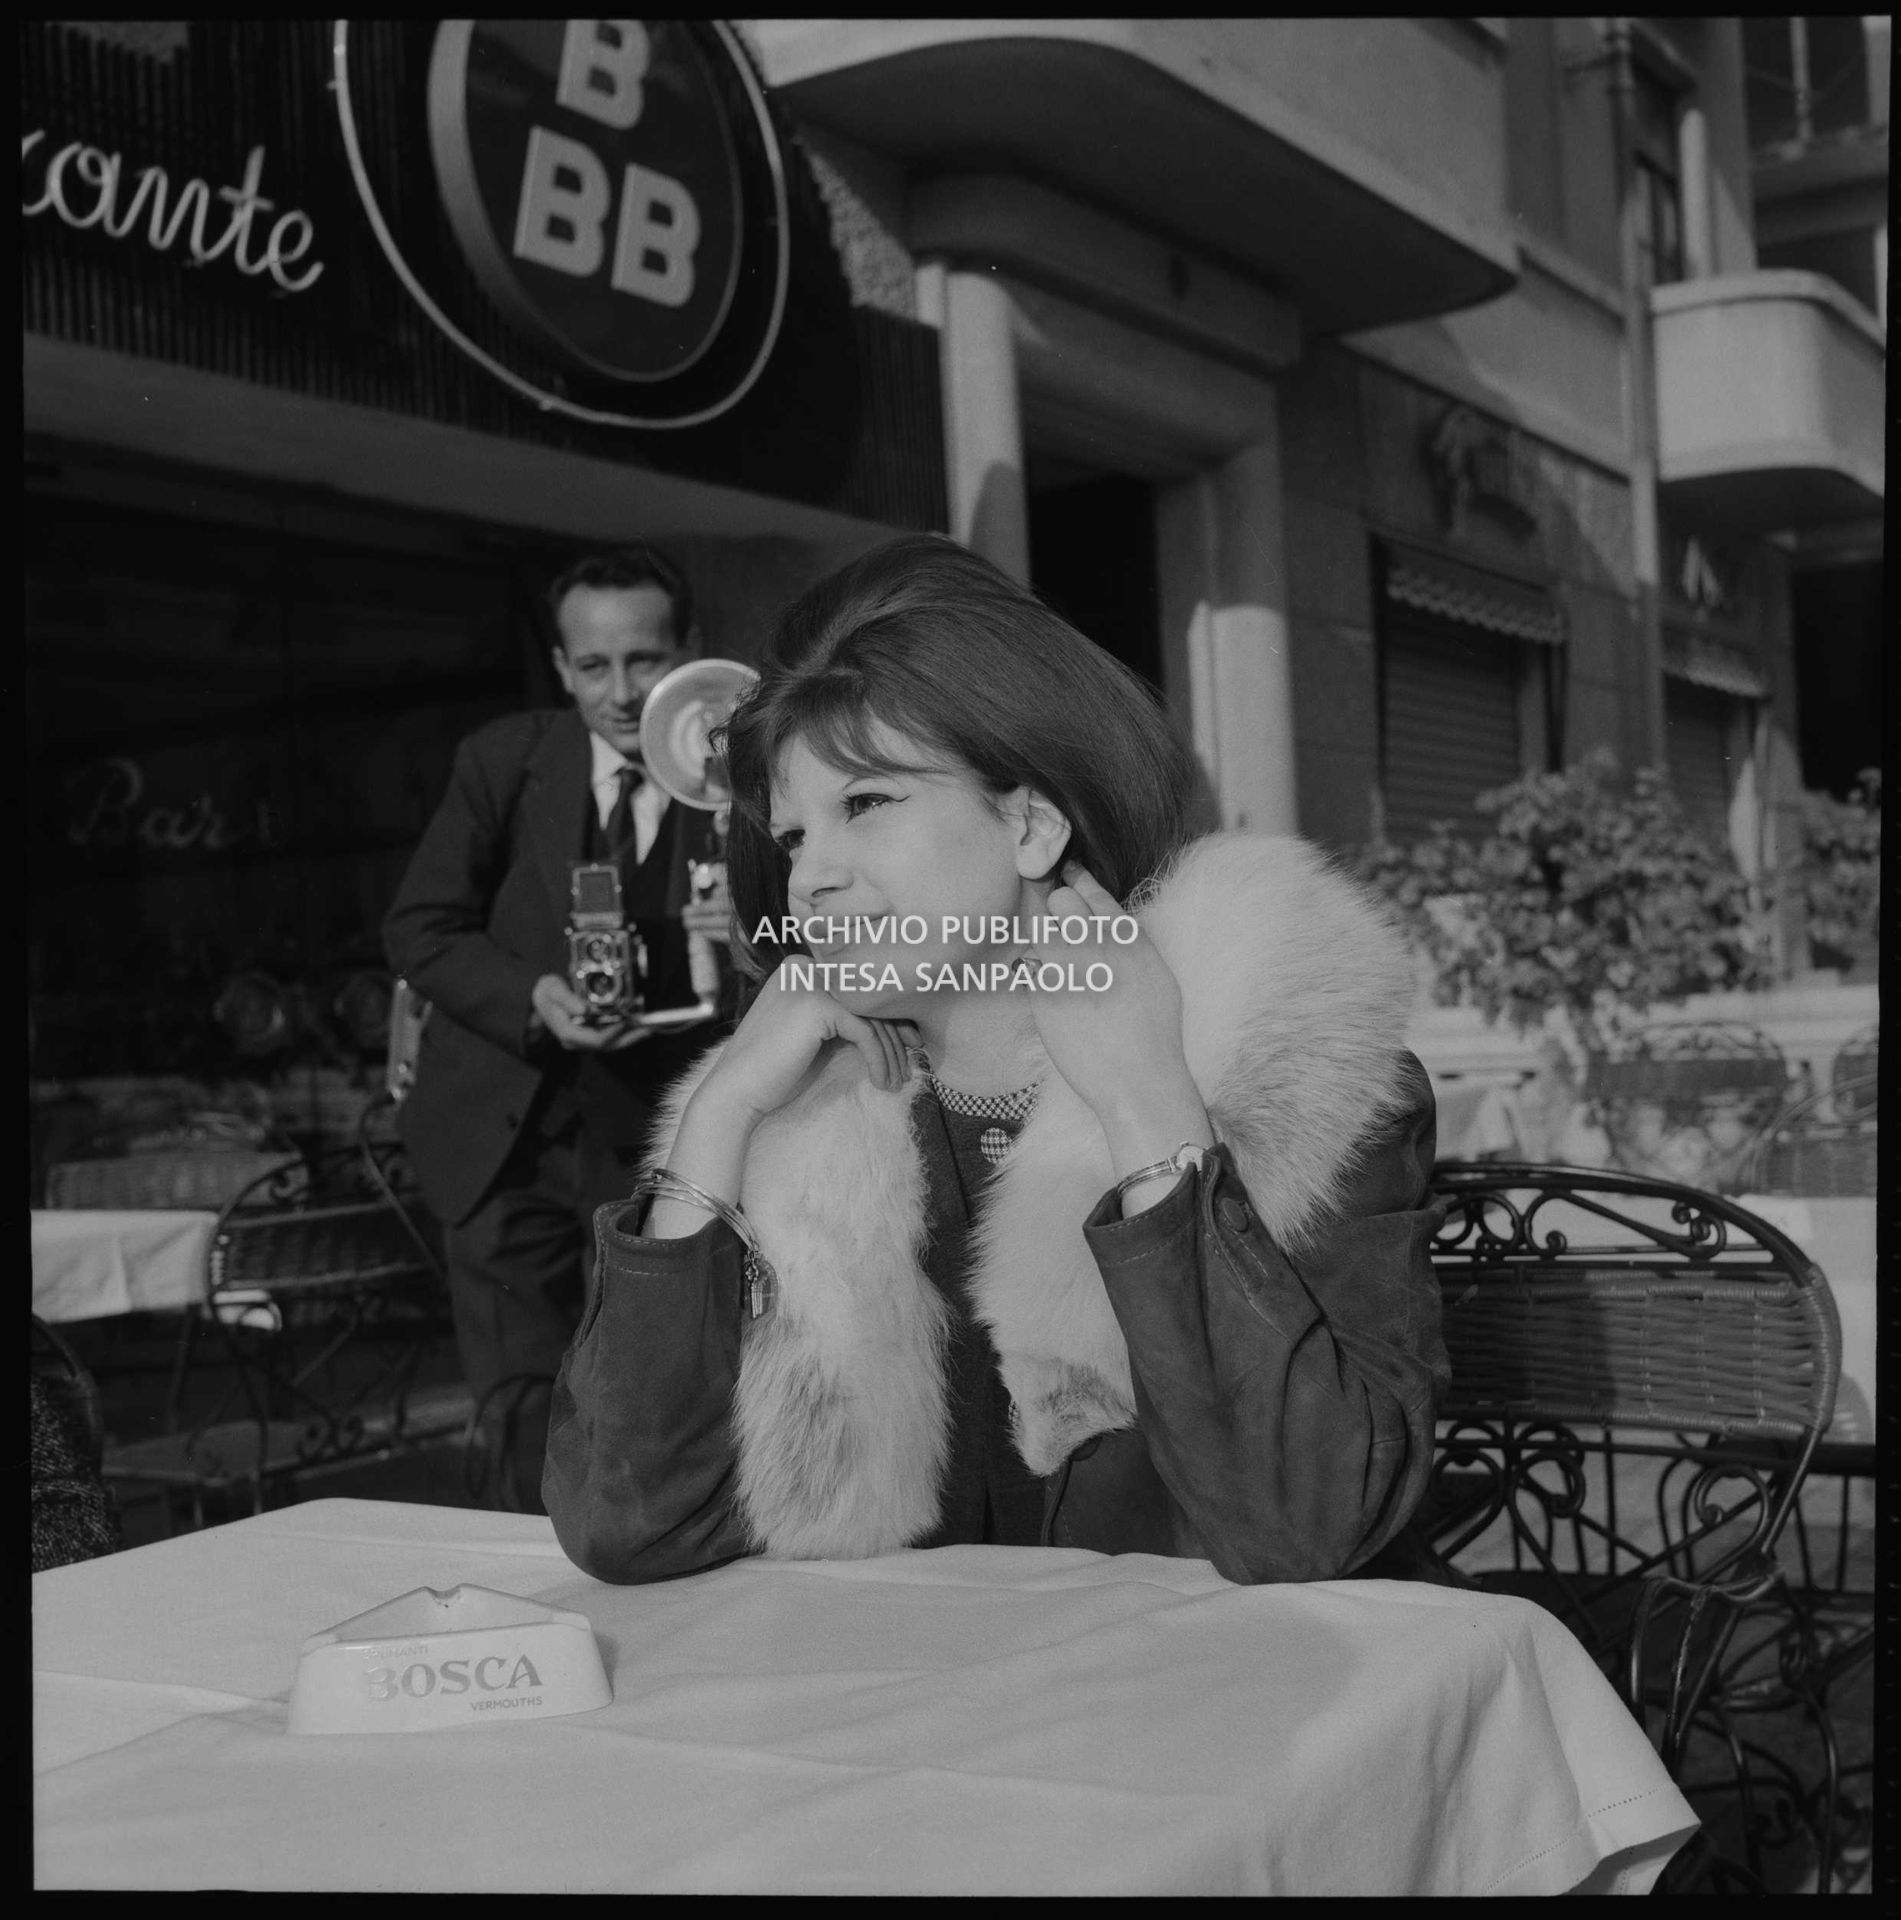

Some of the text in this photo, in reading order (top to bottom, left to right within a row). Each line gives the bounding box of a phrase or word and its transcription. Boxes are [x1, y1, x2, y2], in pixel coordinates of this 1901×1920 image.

[555, 19, 650, 130] B
[364, 1653, 544, 1701] BOSCA
[470, 1696, 543, 1711] VERMOUTHS
